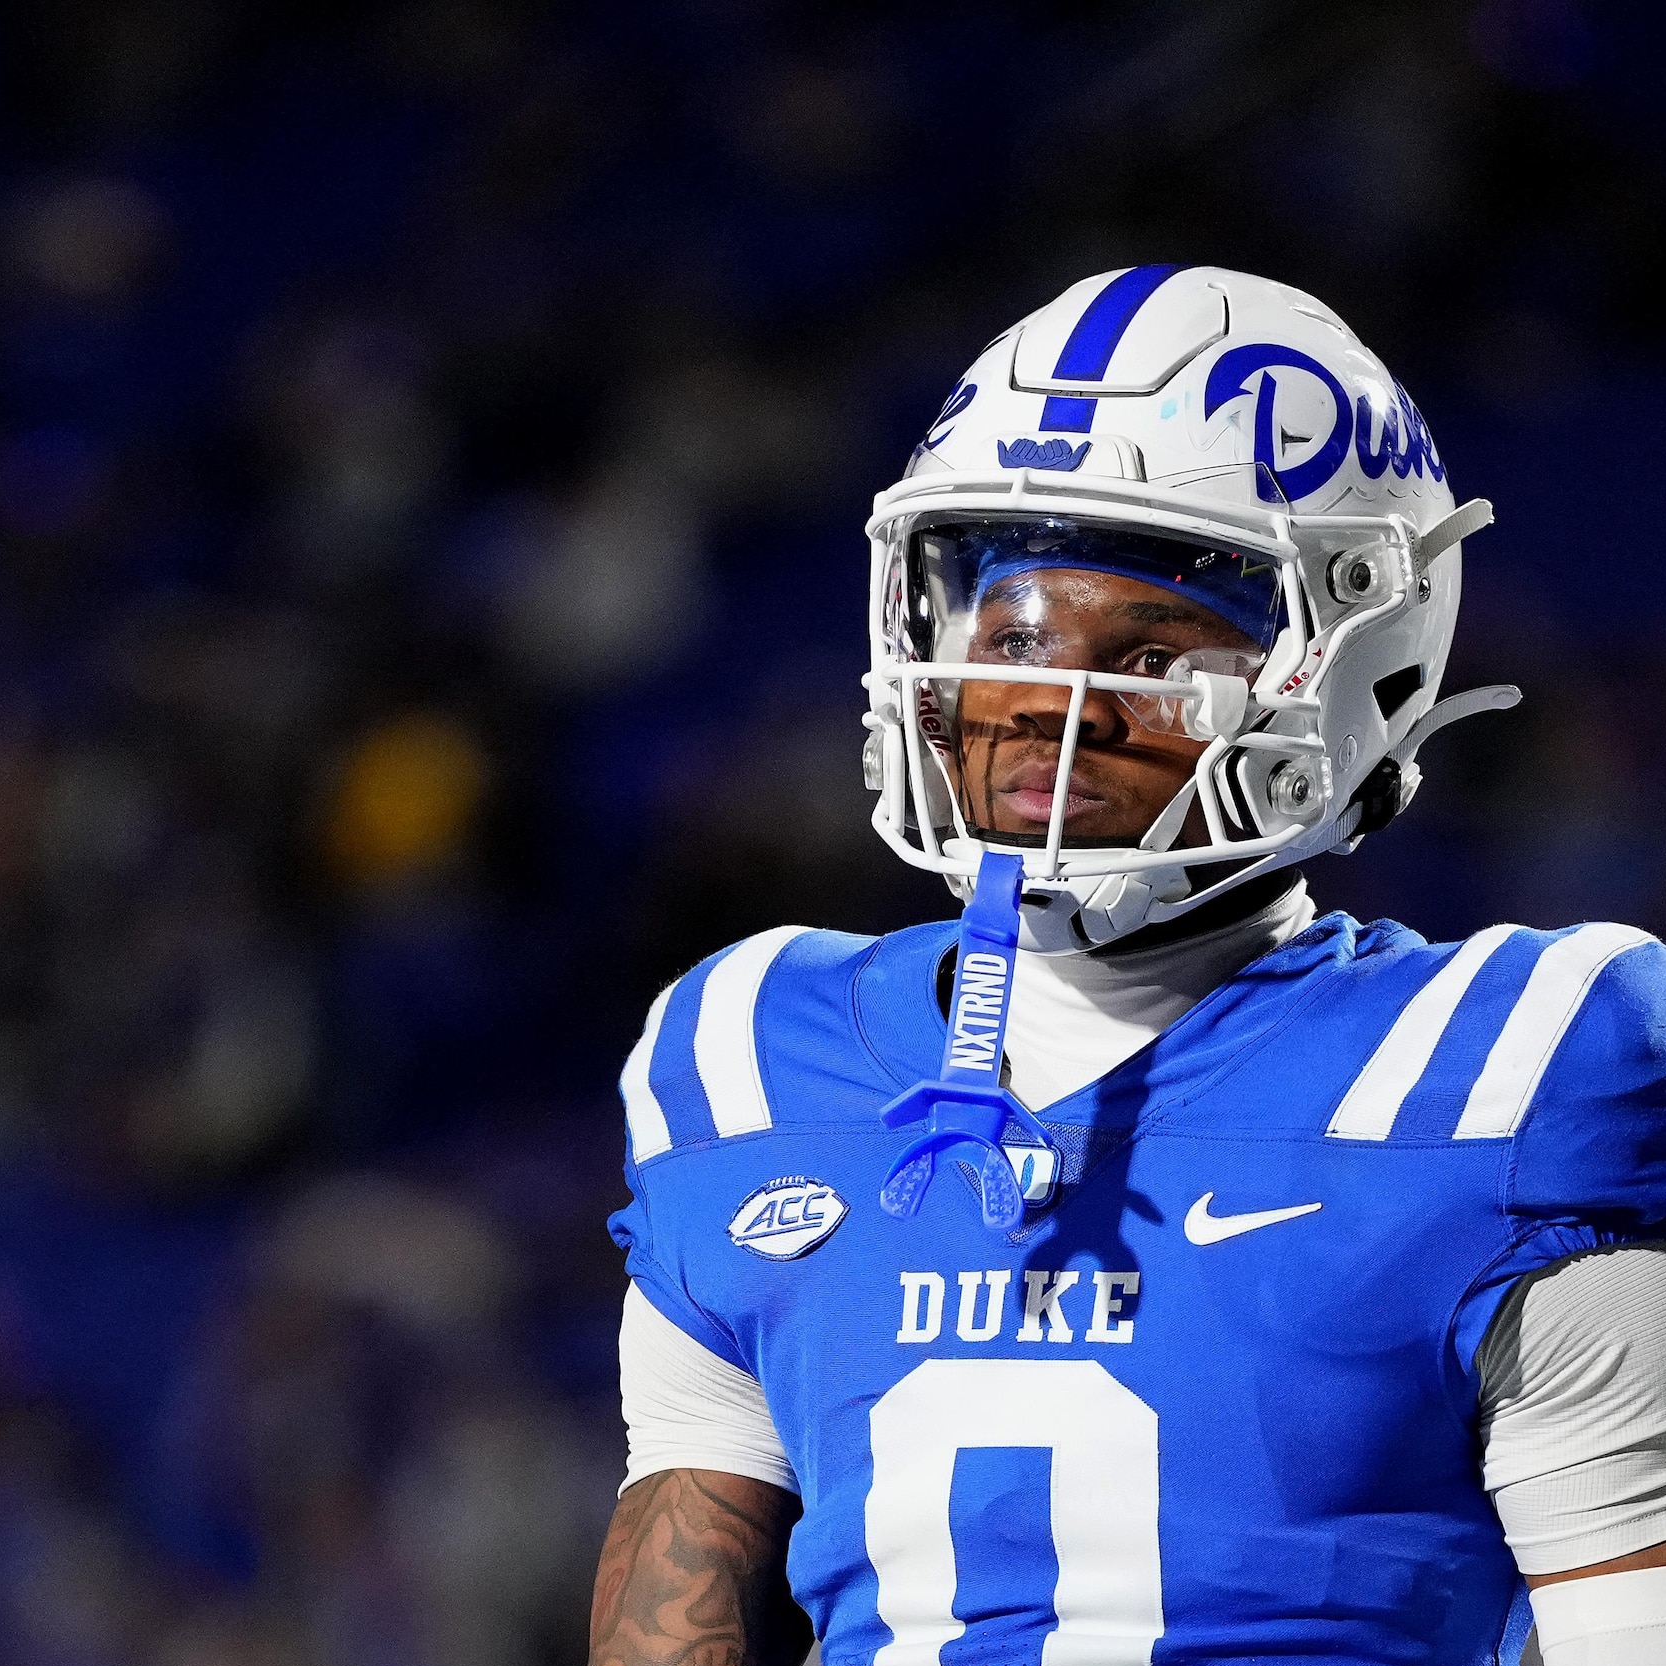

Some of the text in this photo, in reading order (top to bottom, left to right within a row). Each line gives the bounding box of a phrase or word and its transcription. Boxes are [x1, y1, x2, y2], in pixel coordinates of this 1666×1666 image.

[949, 952, 1008, 1072] NXTRND
[744, 1191, 829, 1232] ACC
[896, 1269, 1140, 1344] DUKE
